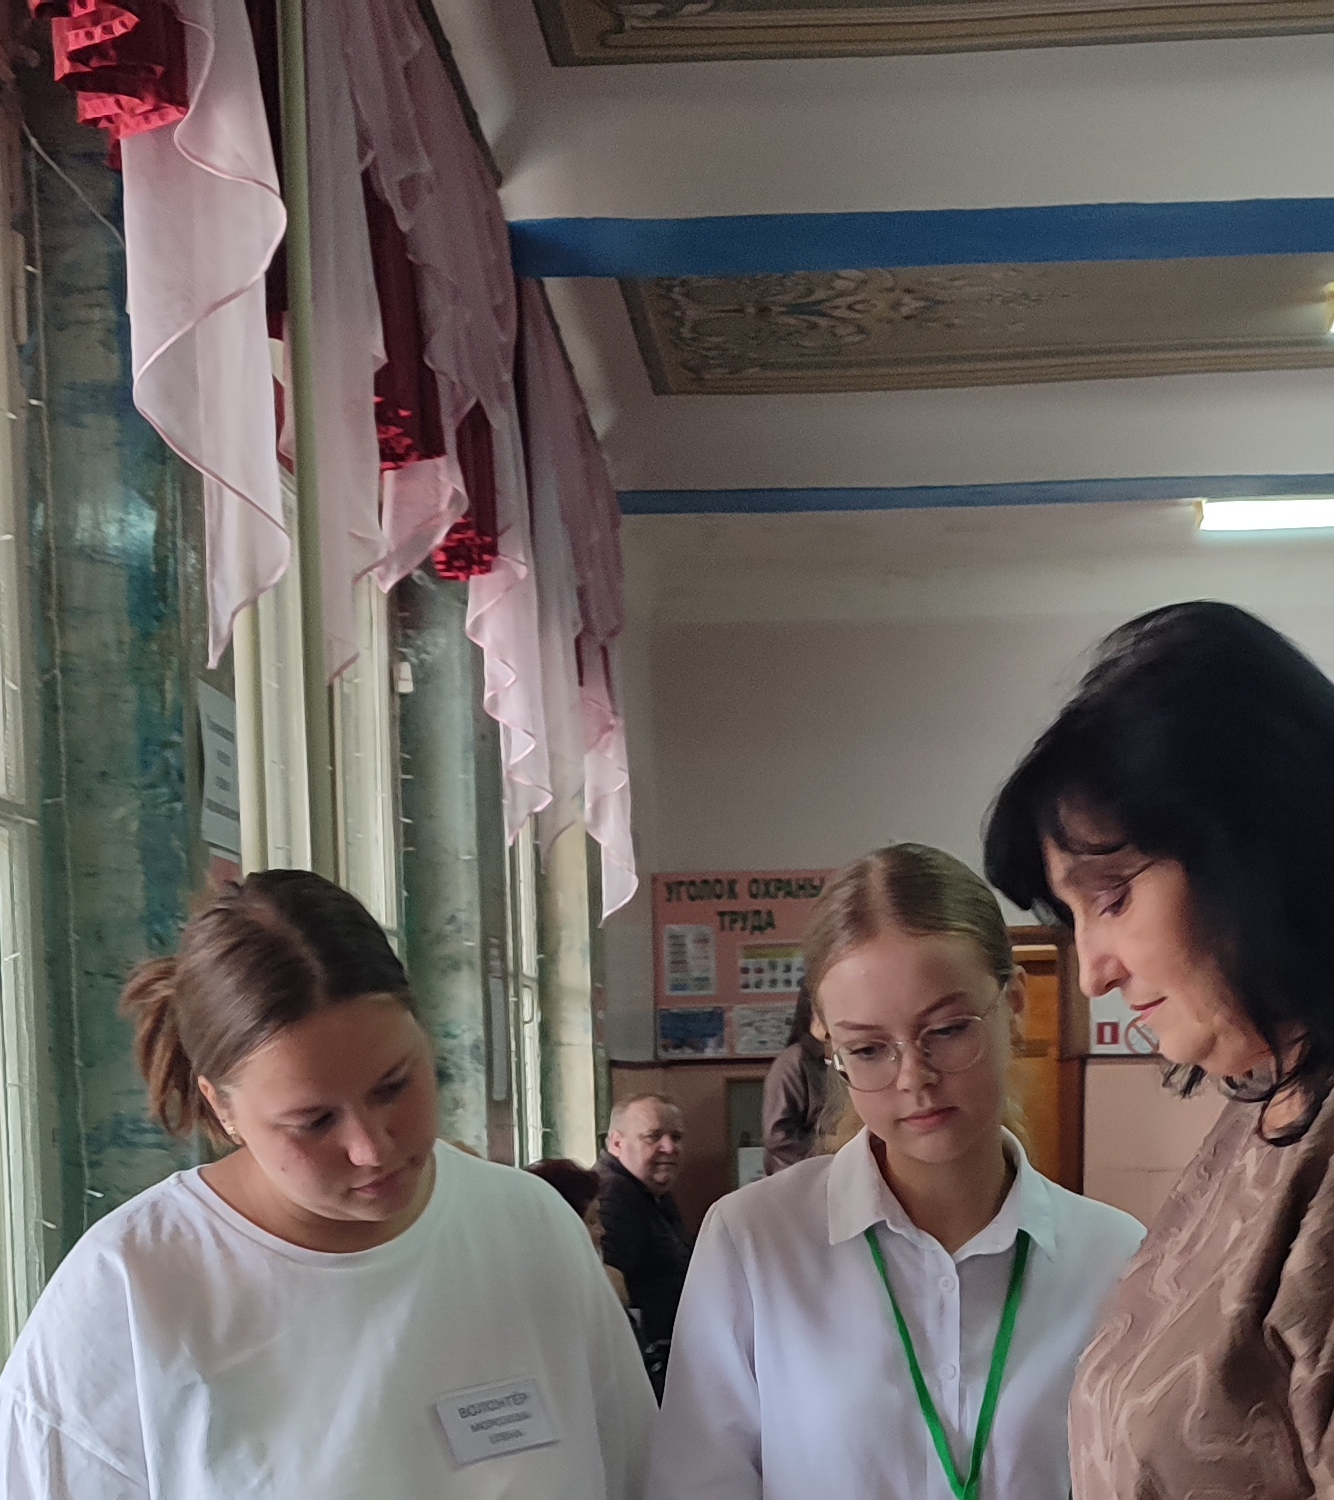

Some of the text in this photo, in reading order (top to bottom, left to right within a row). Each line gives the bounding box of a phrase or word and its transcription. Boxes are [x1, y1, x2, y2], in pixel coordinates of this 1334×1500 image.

[665, 877, 825, 902] УГОЛОК ОХРАНЫ
[717, 910, 776, 934] ТРУДА
